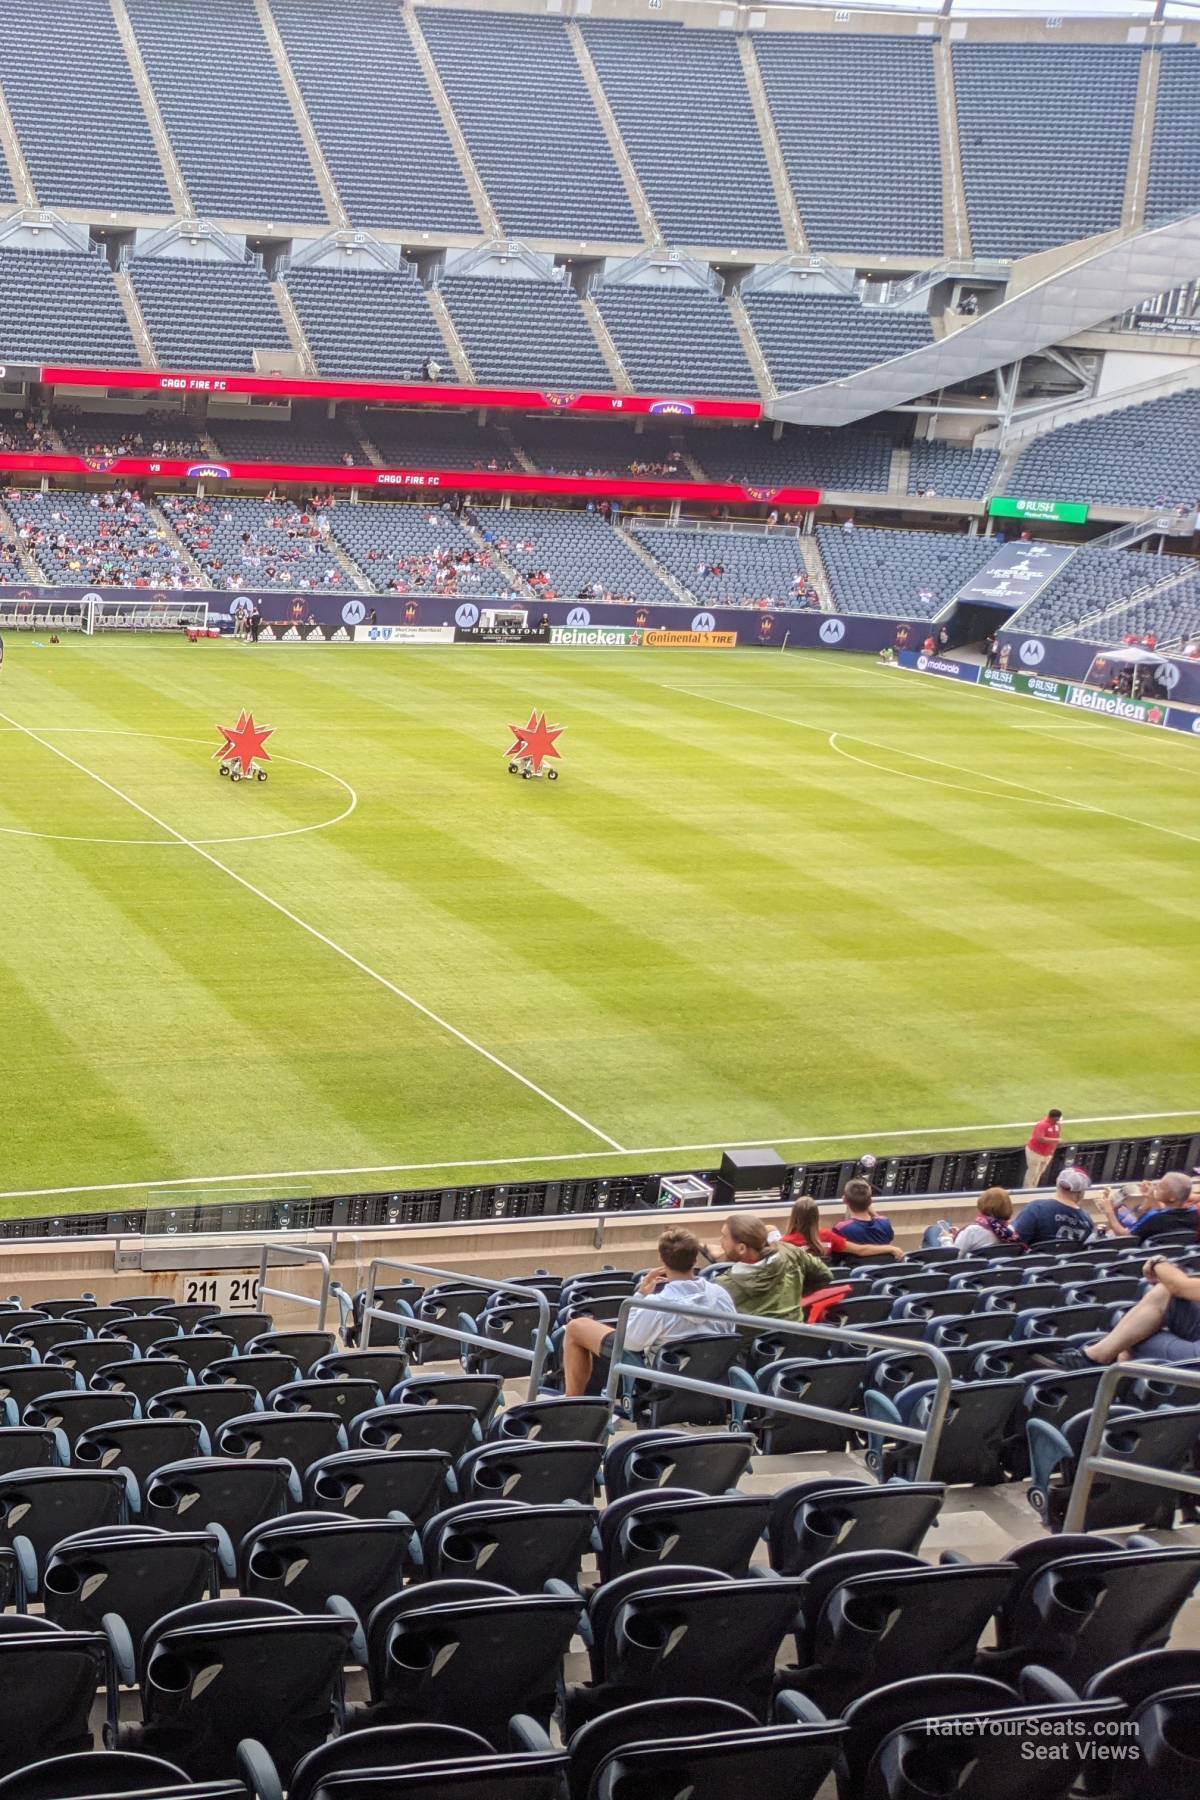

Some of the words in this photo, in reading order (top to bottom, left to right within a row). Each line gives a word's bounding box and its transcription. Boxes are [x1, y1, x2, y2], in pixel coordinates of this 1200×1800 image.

[161, 378, 186, 388] CAGO
[189, 379, 210, 389] FIRE
[214, 380, 226, 390] FC
[611, 400, 623, 408] VS
[405, 475, 425, 485] FIRE
[428, 476, 440, 486] FC
[1025, 501, 1056, 513] RUSH
[472, 627, 545, 635] BLACKSTONE
[550, 629, 625, 645] Heineken
[646, 631, 701, 644] Continental
[712, 635, 733, 644] TIRE
[927, 660, 960, 675] motorola
[991, 670, 1013, 684] RUSH
[1035, 679, 1058, 693] RUSH
[1070, 687, 1146, 721] Heineken
[186, 1280, 217, 1303] 211
